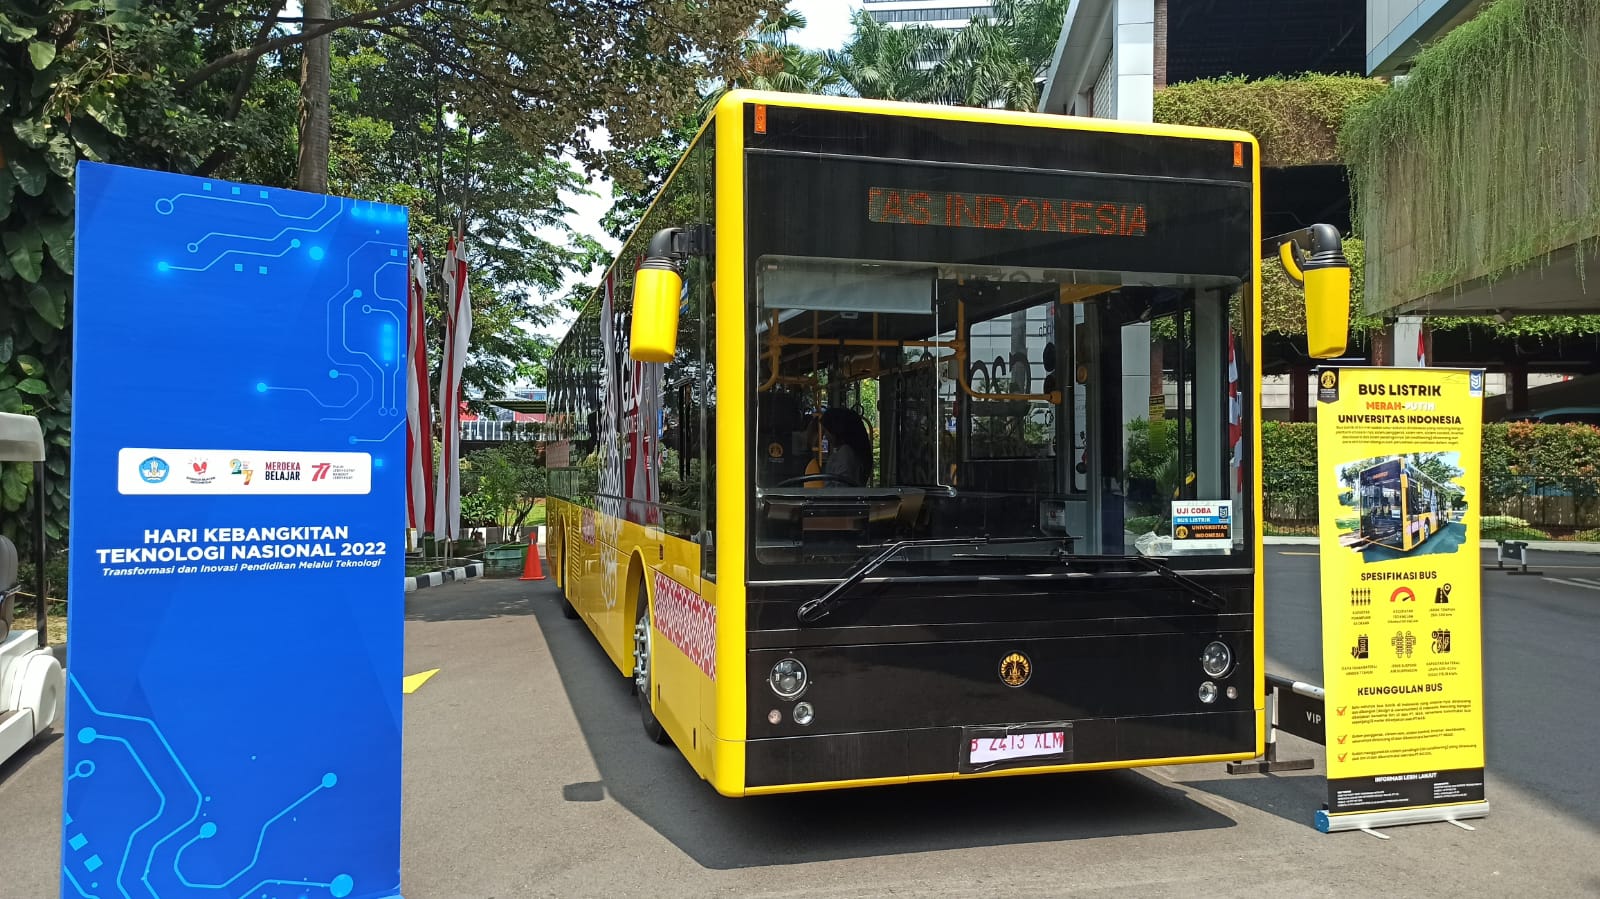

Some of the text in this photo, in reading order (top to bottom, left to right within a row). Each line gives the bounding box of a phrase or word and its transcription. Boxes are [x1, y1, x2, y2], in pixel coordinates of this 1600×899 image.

[945, 194, 1147, 236] INDONESIA
[1358, 384, 1441, 396] BUS LISTRIK
[1366, 402, 1435, 411] MERAH-PUTIH
[1338, 415, 1461, 425] UNIVERSITAS INDONESIA
[265, 461, 301, 471] MERDEKA
[265, 471, 301, 481] BELAJAR
[144, 525, 348, 544] HARI KEBANGKITAN
[96, 541, 386, 564] TEKNOLOGI NASIONAL 2022
[102, 558, 381, 577] Transformasi dan Inovasi Pendidikan Melalui Teknologi
[1361, 571, 1437, 581] SPESIFIKASI BUS
[1357, 683, 1443, 696] KEUNGGULAN BUS
[1306, 711, 1322, 724] VIP
[1034, 731, 1065, 749] XLM
[1374, 775, 1403, 783] INFORMASI
